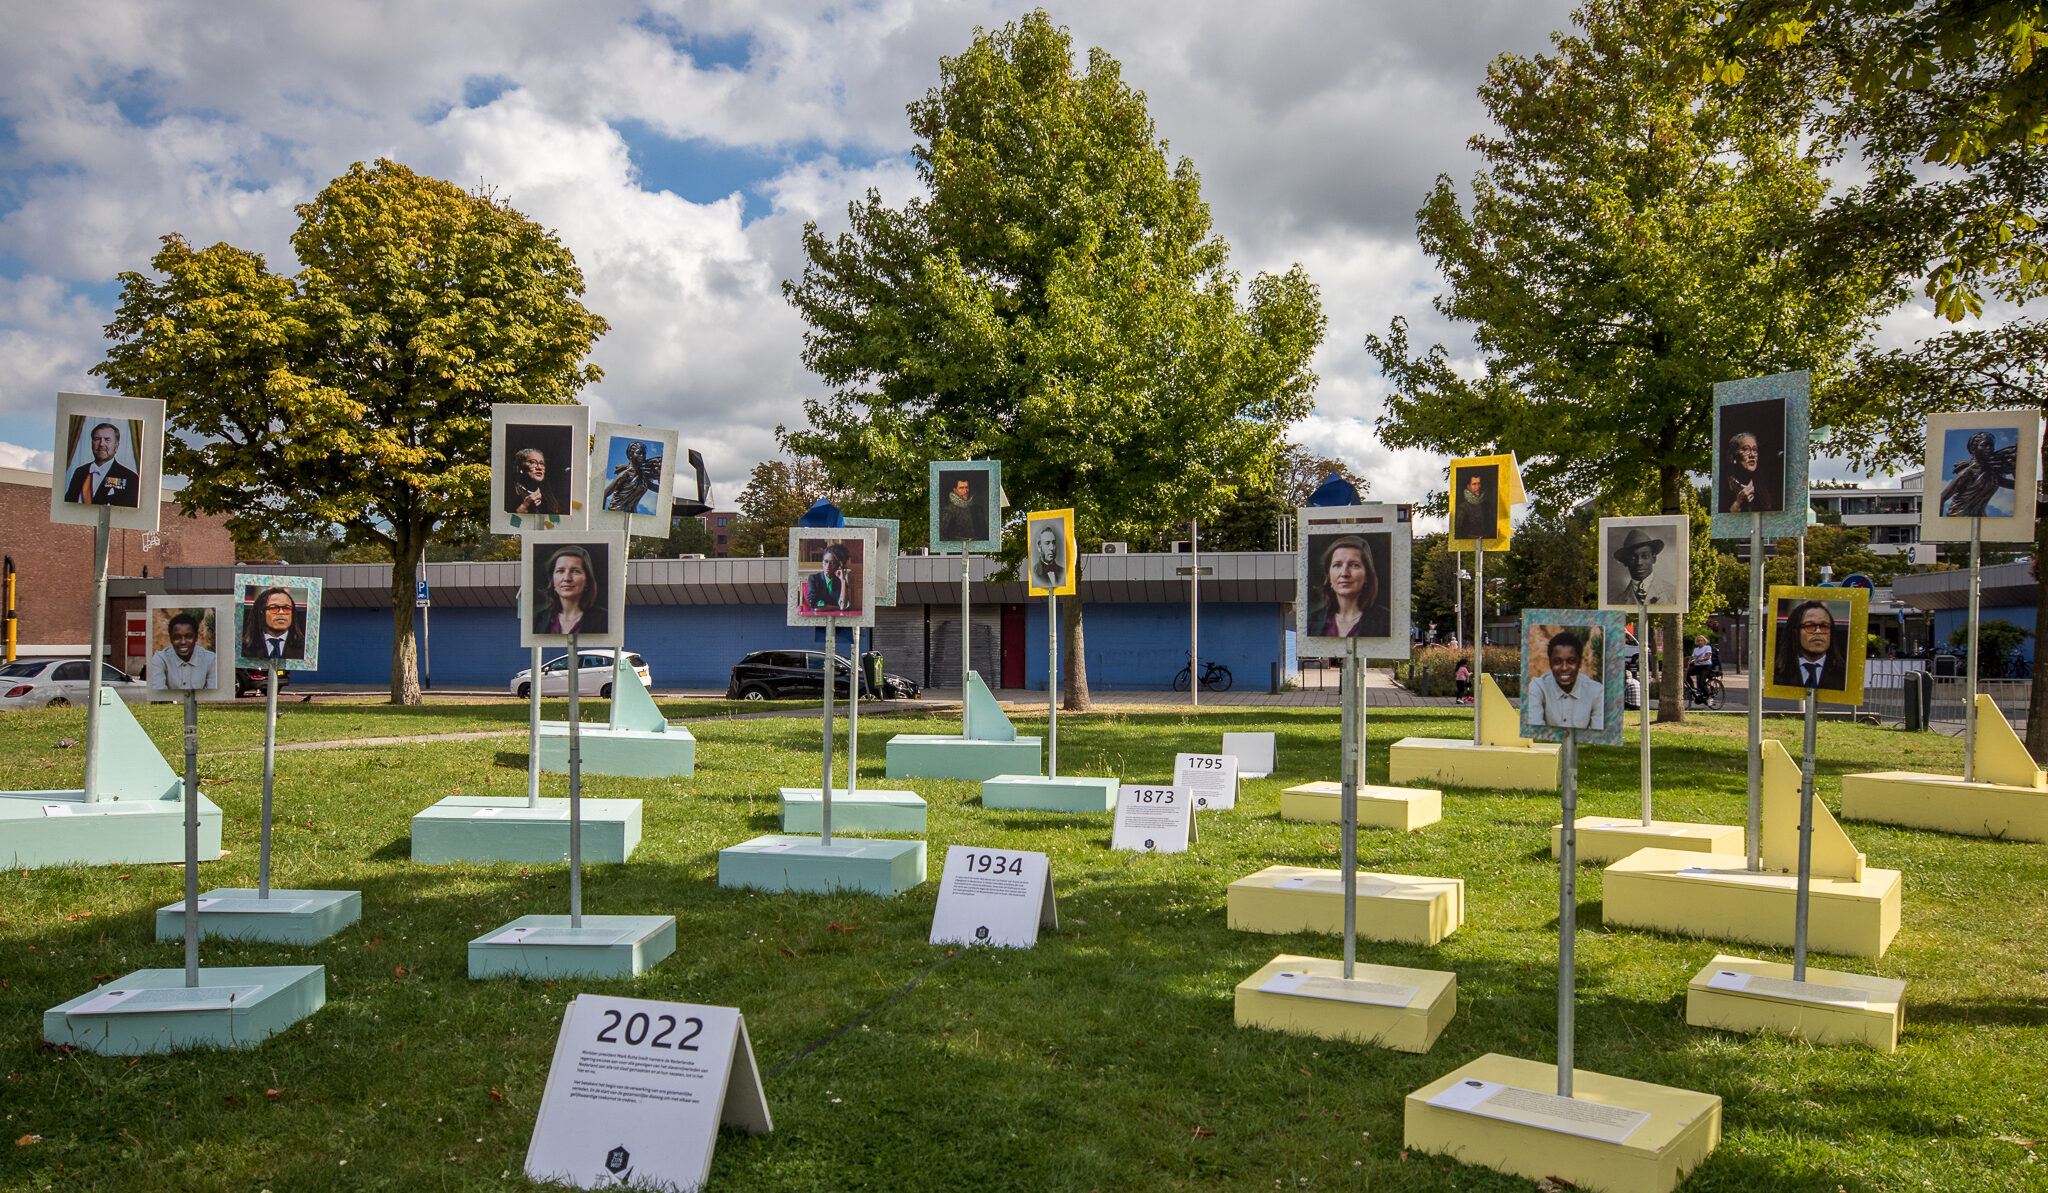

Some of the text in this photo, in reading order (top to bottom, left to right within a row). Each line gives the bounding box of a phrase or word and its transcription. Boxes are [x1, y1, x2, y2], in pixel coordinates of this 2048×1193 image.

[1189, 758, 1221, 769] 1795
[1135, 790, 1173, 803] 1873
[967, 855, 1022, 875] 1934
[597, 1010, 703, 1051] 2022
